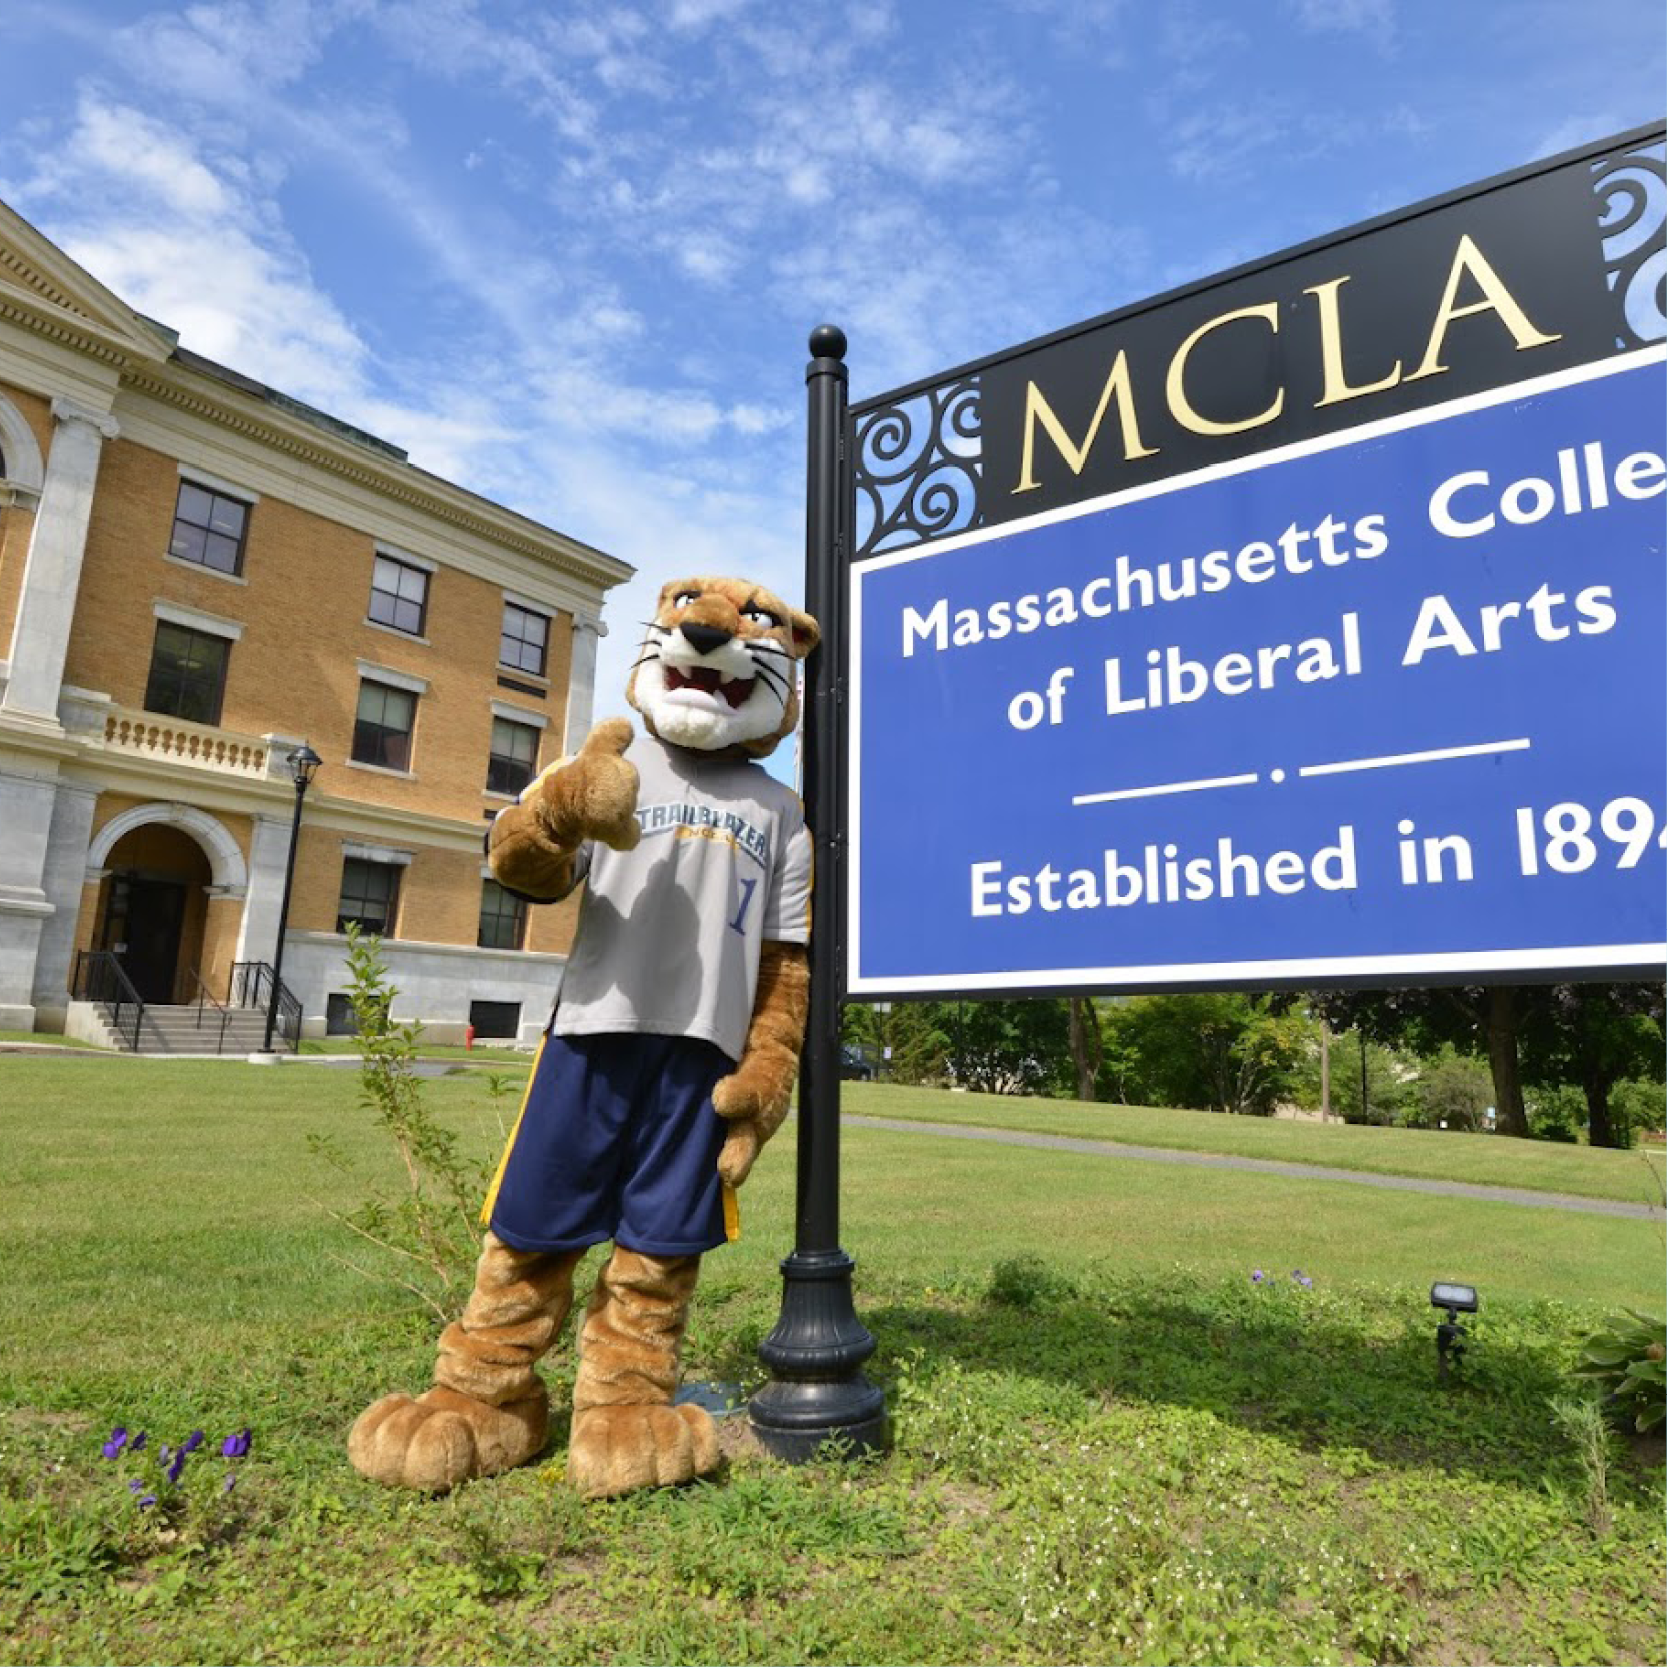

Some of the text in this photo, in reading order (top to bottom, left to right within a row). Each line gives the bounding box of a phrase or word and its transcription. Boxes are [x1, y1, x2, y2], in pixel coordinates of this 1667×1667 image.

[1012, 234, 1562, 494] MCLA
[902, 441, 1667, 658] Massachusetts Colle
[1007, 584, 1617, 730] of Liberal Arts
[730, 878, 757, 936] 1
[971, 796, 1667, 917] Established in 189
